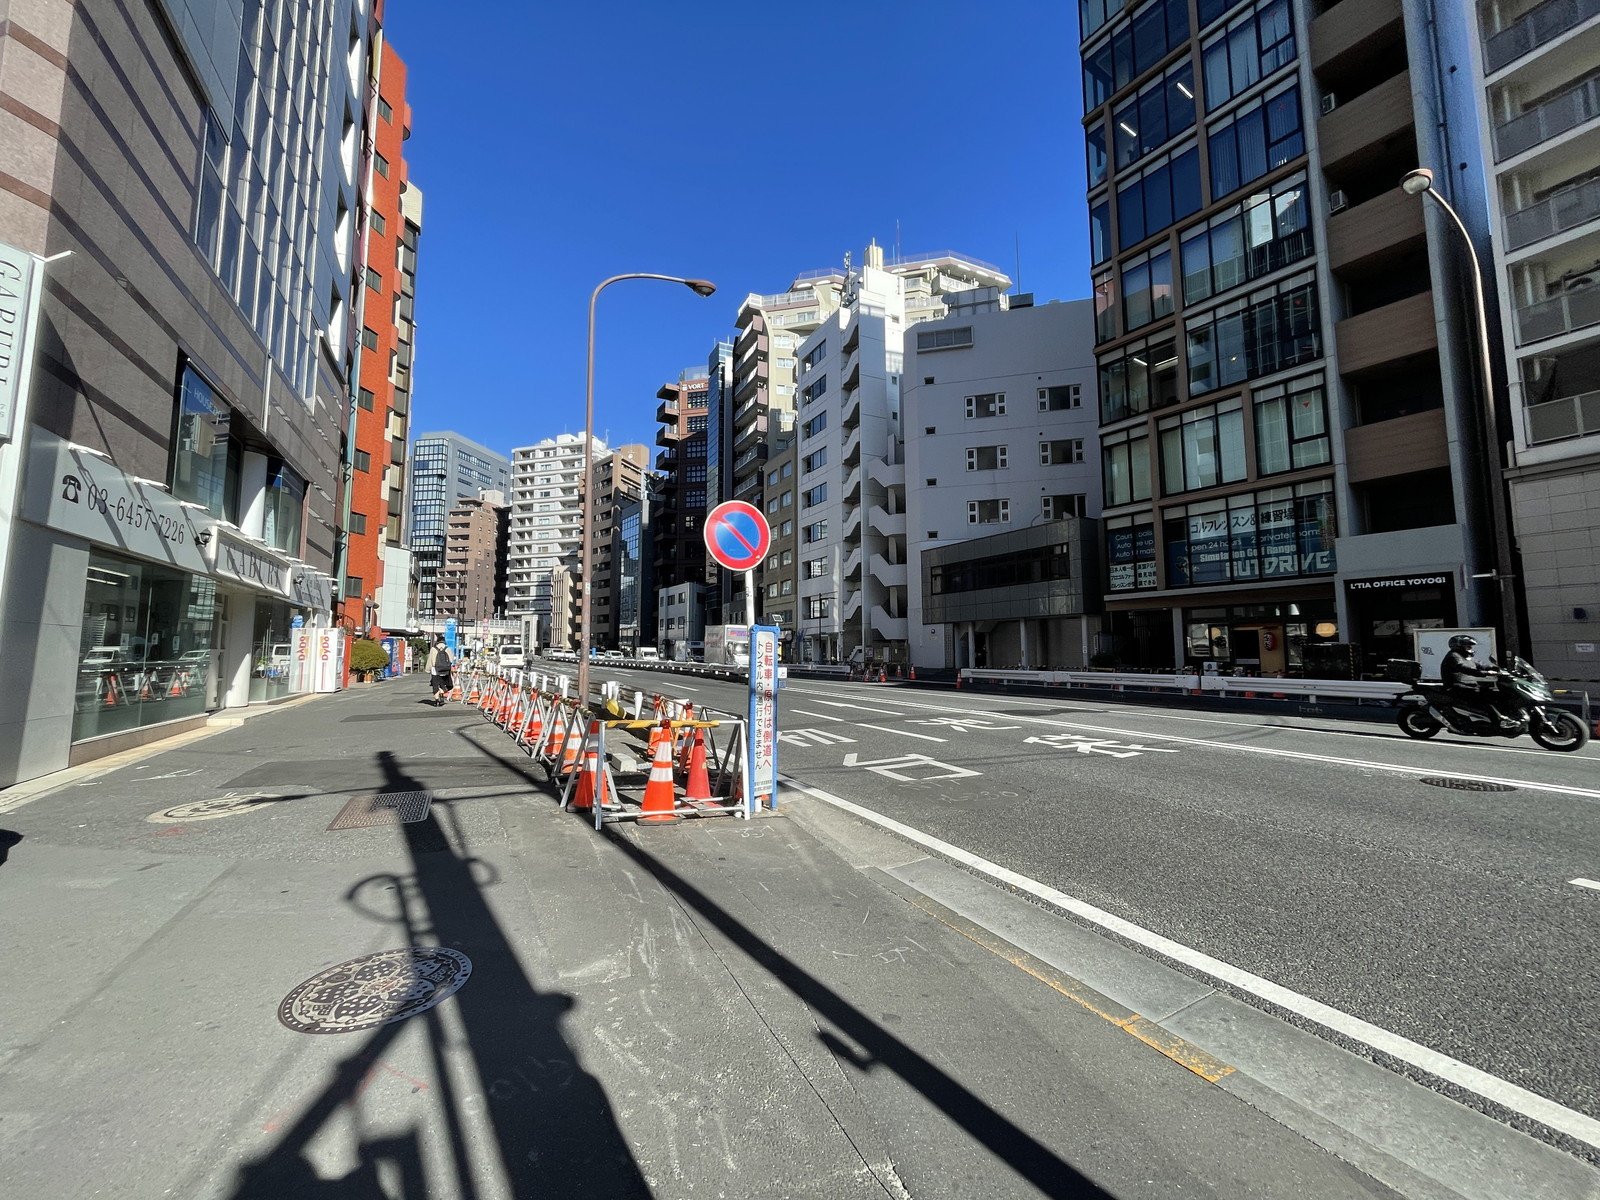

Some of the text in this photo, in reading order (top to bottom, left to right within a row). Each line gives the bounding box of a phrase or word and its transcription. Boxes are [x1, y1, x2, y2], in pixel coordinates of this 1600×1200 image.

[0, 259, 22, 386] GAB
[688, 382, 705, 390] VORT
[87, 483, 185, 545] 03-6457-7226
[1200, 544, 1297, 563] Simulaion Gof Range
[1219, 538, 1242, 548] hors
[226, 543, 280, 587] GABURI
[1373, 579, 1406, 588] OFFICE
[1407, 576, 1446, 586] YOYOGI
[321, 636, 331, 661] DyDo
[763, 641, 773, 769] 自転車・原付は側道へ
